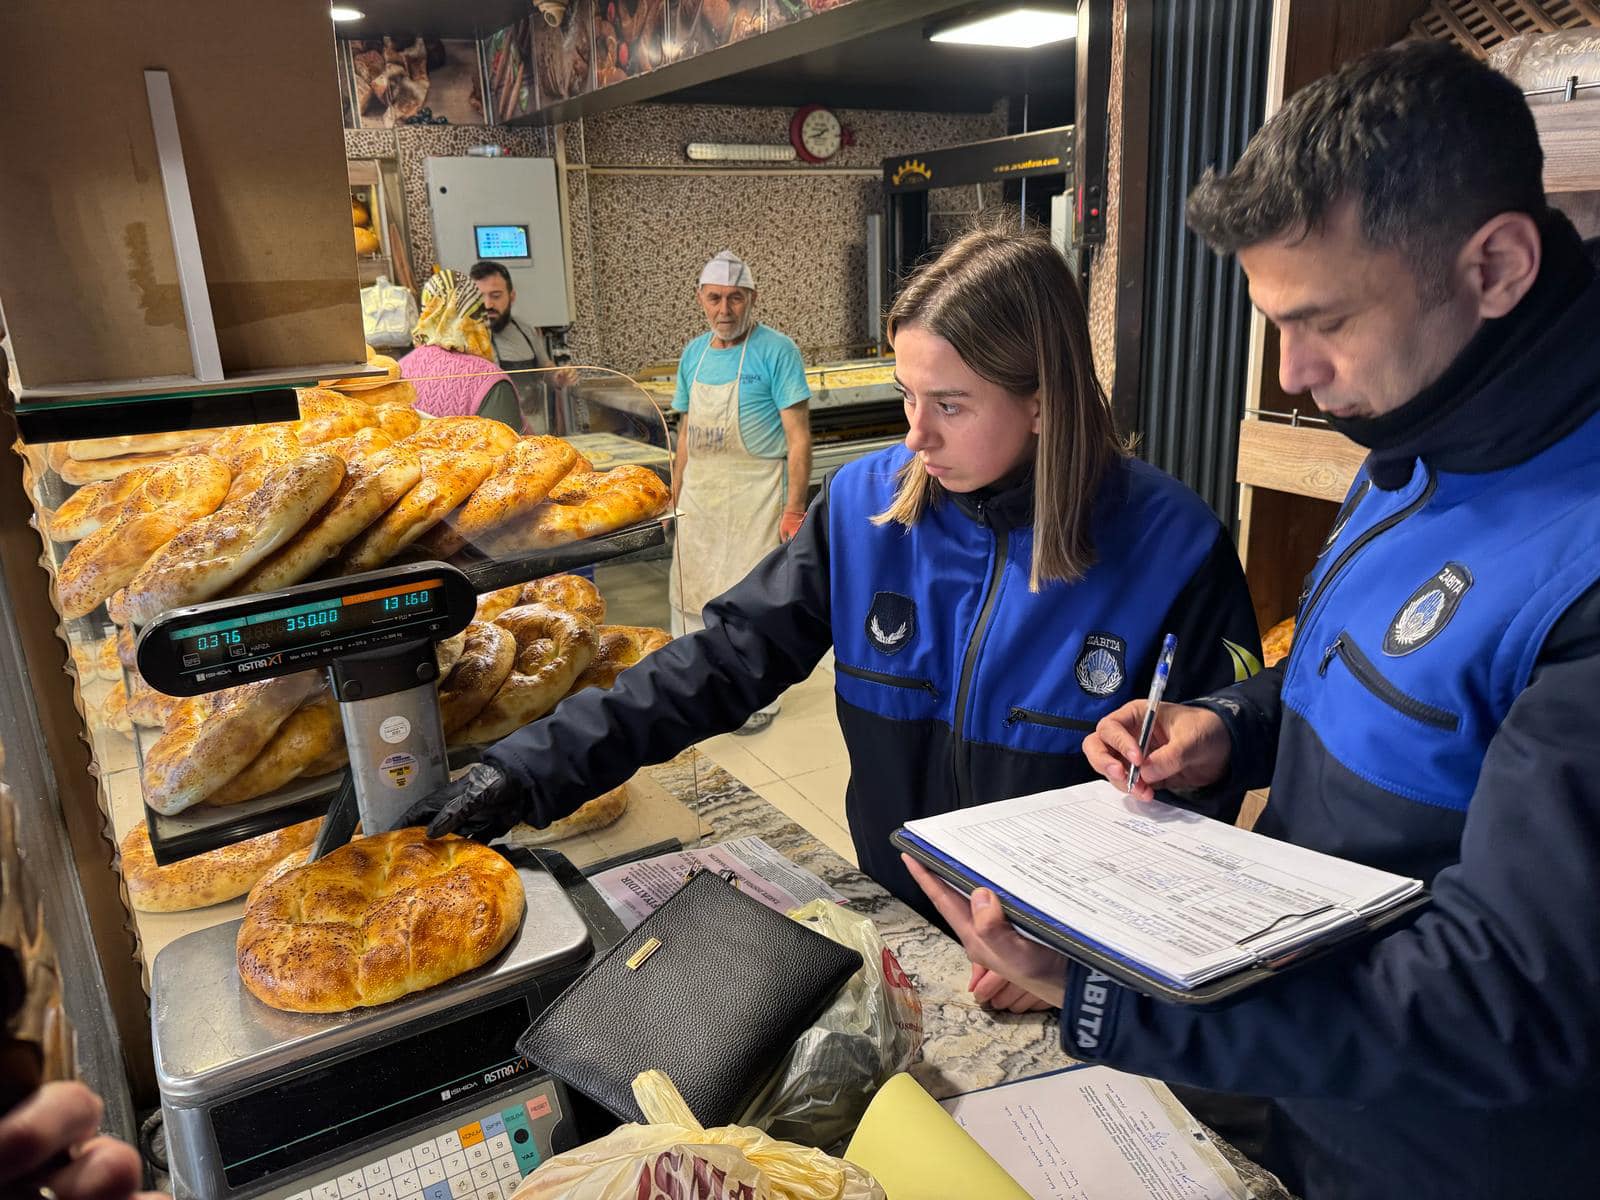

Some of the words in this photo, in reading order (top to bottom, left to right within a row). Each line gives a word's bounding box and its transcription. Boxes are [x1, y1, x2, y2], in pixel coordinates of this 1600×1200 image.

[1438, 567, 1465, 596] ZABITA
[286, 609, 338, 631] 350.00
[197, 630, 241, 650] 0.376
[1086, 635, 1121, 652] ZABITA
[238, 659, 268, 673] ASTRA
[451, 1081, 479, 1096] ISHIDA
[484, 1064, 515, 1085] ASTRA
[445, 1137, 453, 1145] P
[496, 1141, 504, 1149] 9
[521, 1151, 535, 1161] YAZ
[503, 1161, 511, 1169] 6
[508, 1182, 517, 1190] 3
